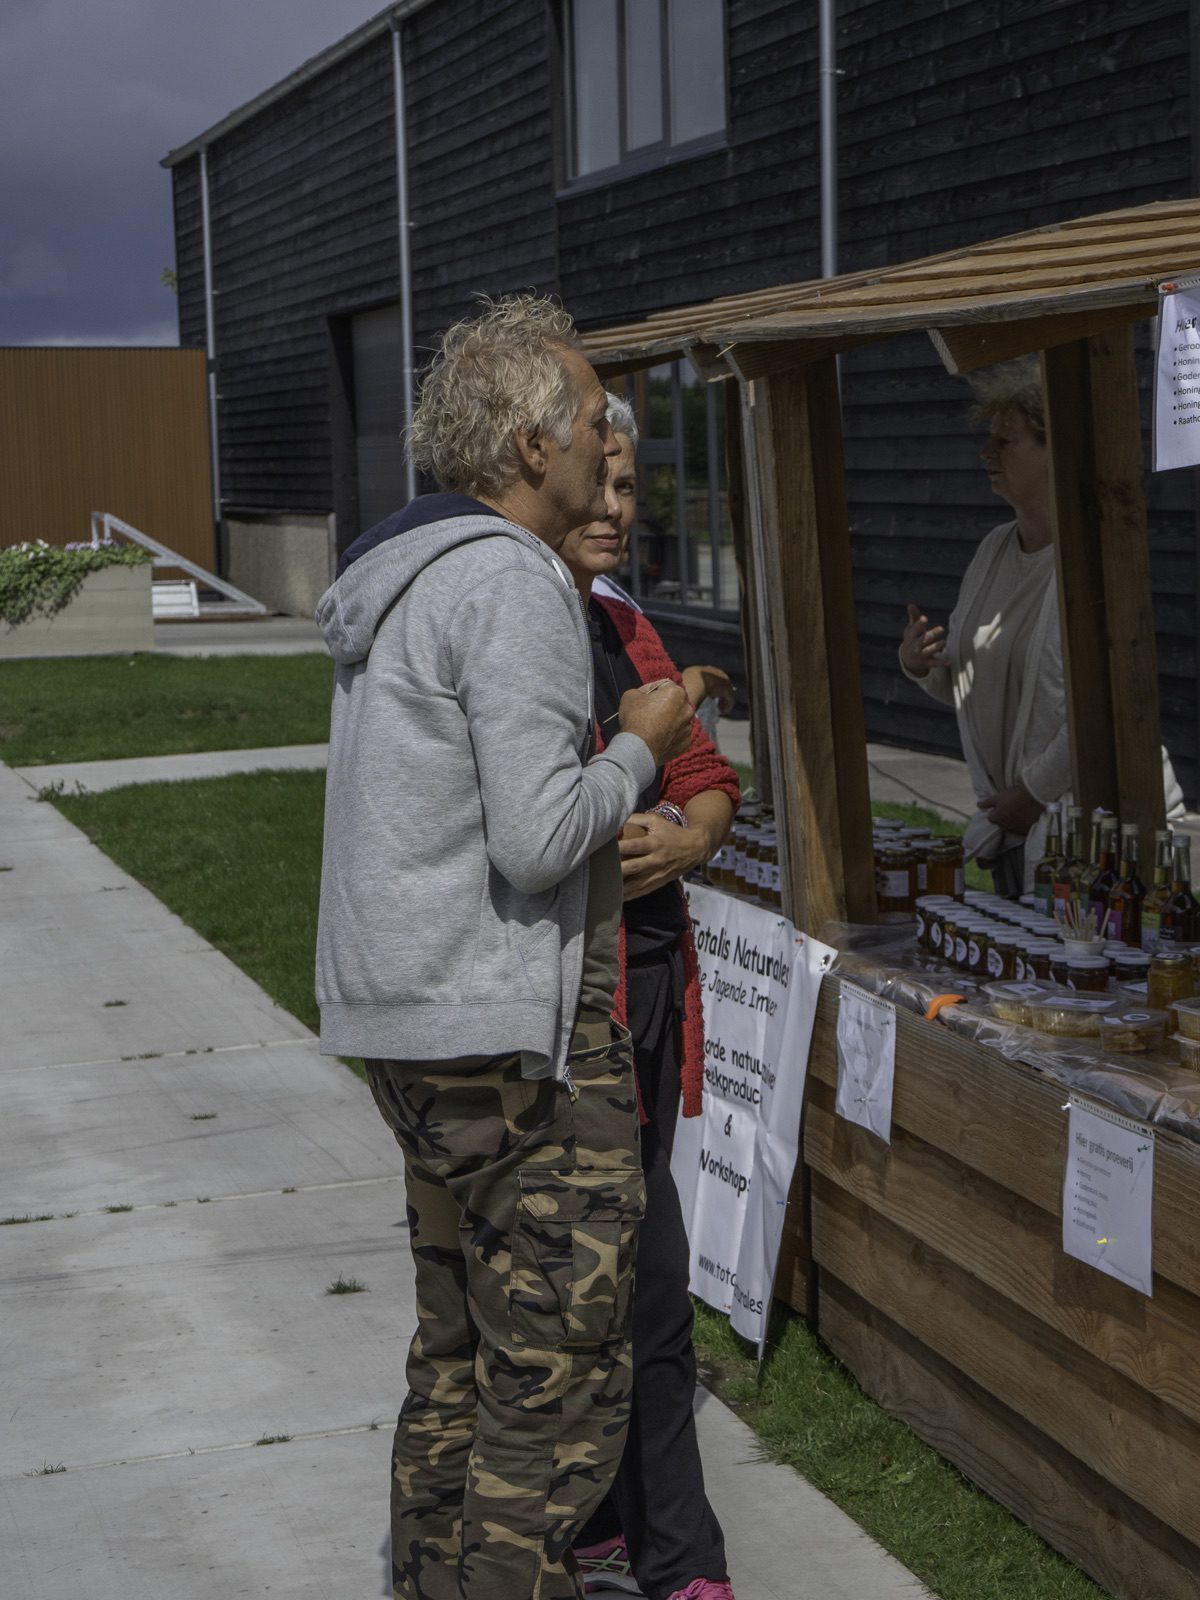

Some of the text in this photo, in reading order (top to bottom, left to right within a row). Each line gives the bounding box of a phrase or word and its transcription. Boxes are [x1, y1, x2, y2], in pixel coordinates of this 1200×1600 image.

[692, 918, 790, 988] Totalis Naturales
[708, 969, 747, 1006] Jagende
[724, 1113, 733, 1138] &
